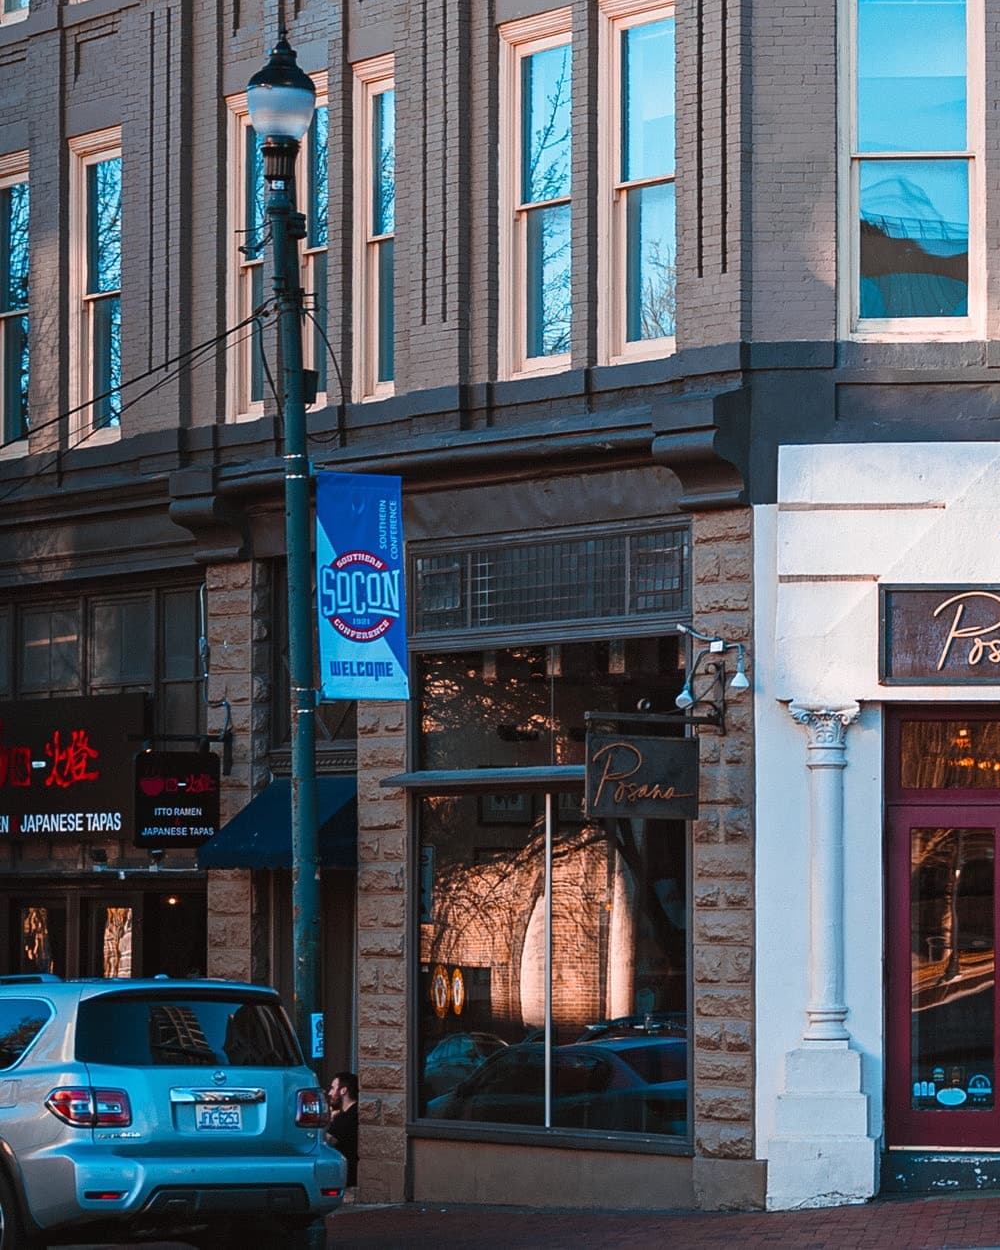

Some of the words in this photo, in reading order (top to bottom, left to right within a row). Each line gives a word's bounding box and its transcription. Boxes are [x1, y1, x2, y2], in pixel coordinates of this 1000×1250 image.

[379, 500, 387, 550] SOUTHERN
[390, 500, 398, 560] CONFERENCE
[336, 553, 383, 568] SOUTHERN
[322, 567, 399, 617] SOCON
[334, 618, 389, 639] CONFERENCE
[592, 742, 695, 807] Posana
[20, 813, 84, 832] JAPANESE
[85, 812, 121, 831] TAPAS
[154, 808, 172, 816] ITTO
[174, 808, 202, 816] RAMEN
[142, 827, 187, 836] JAPANESE
[189, 827, 214, 836] TAPAS
